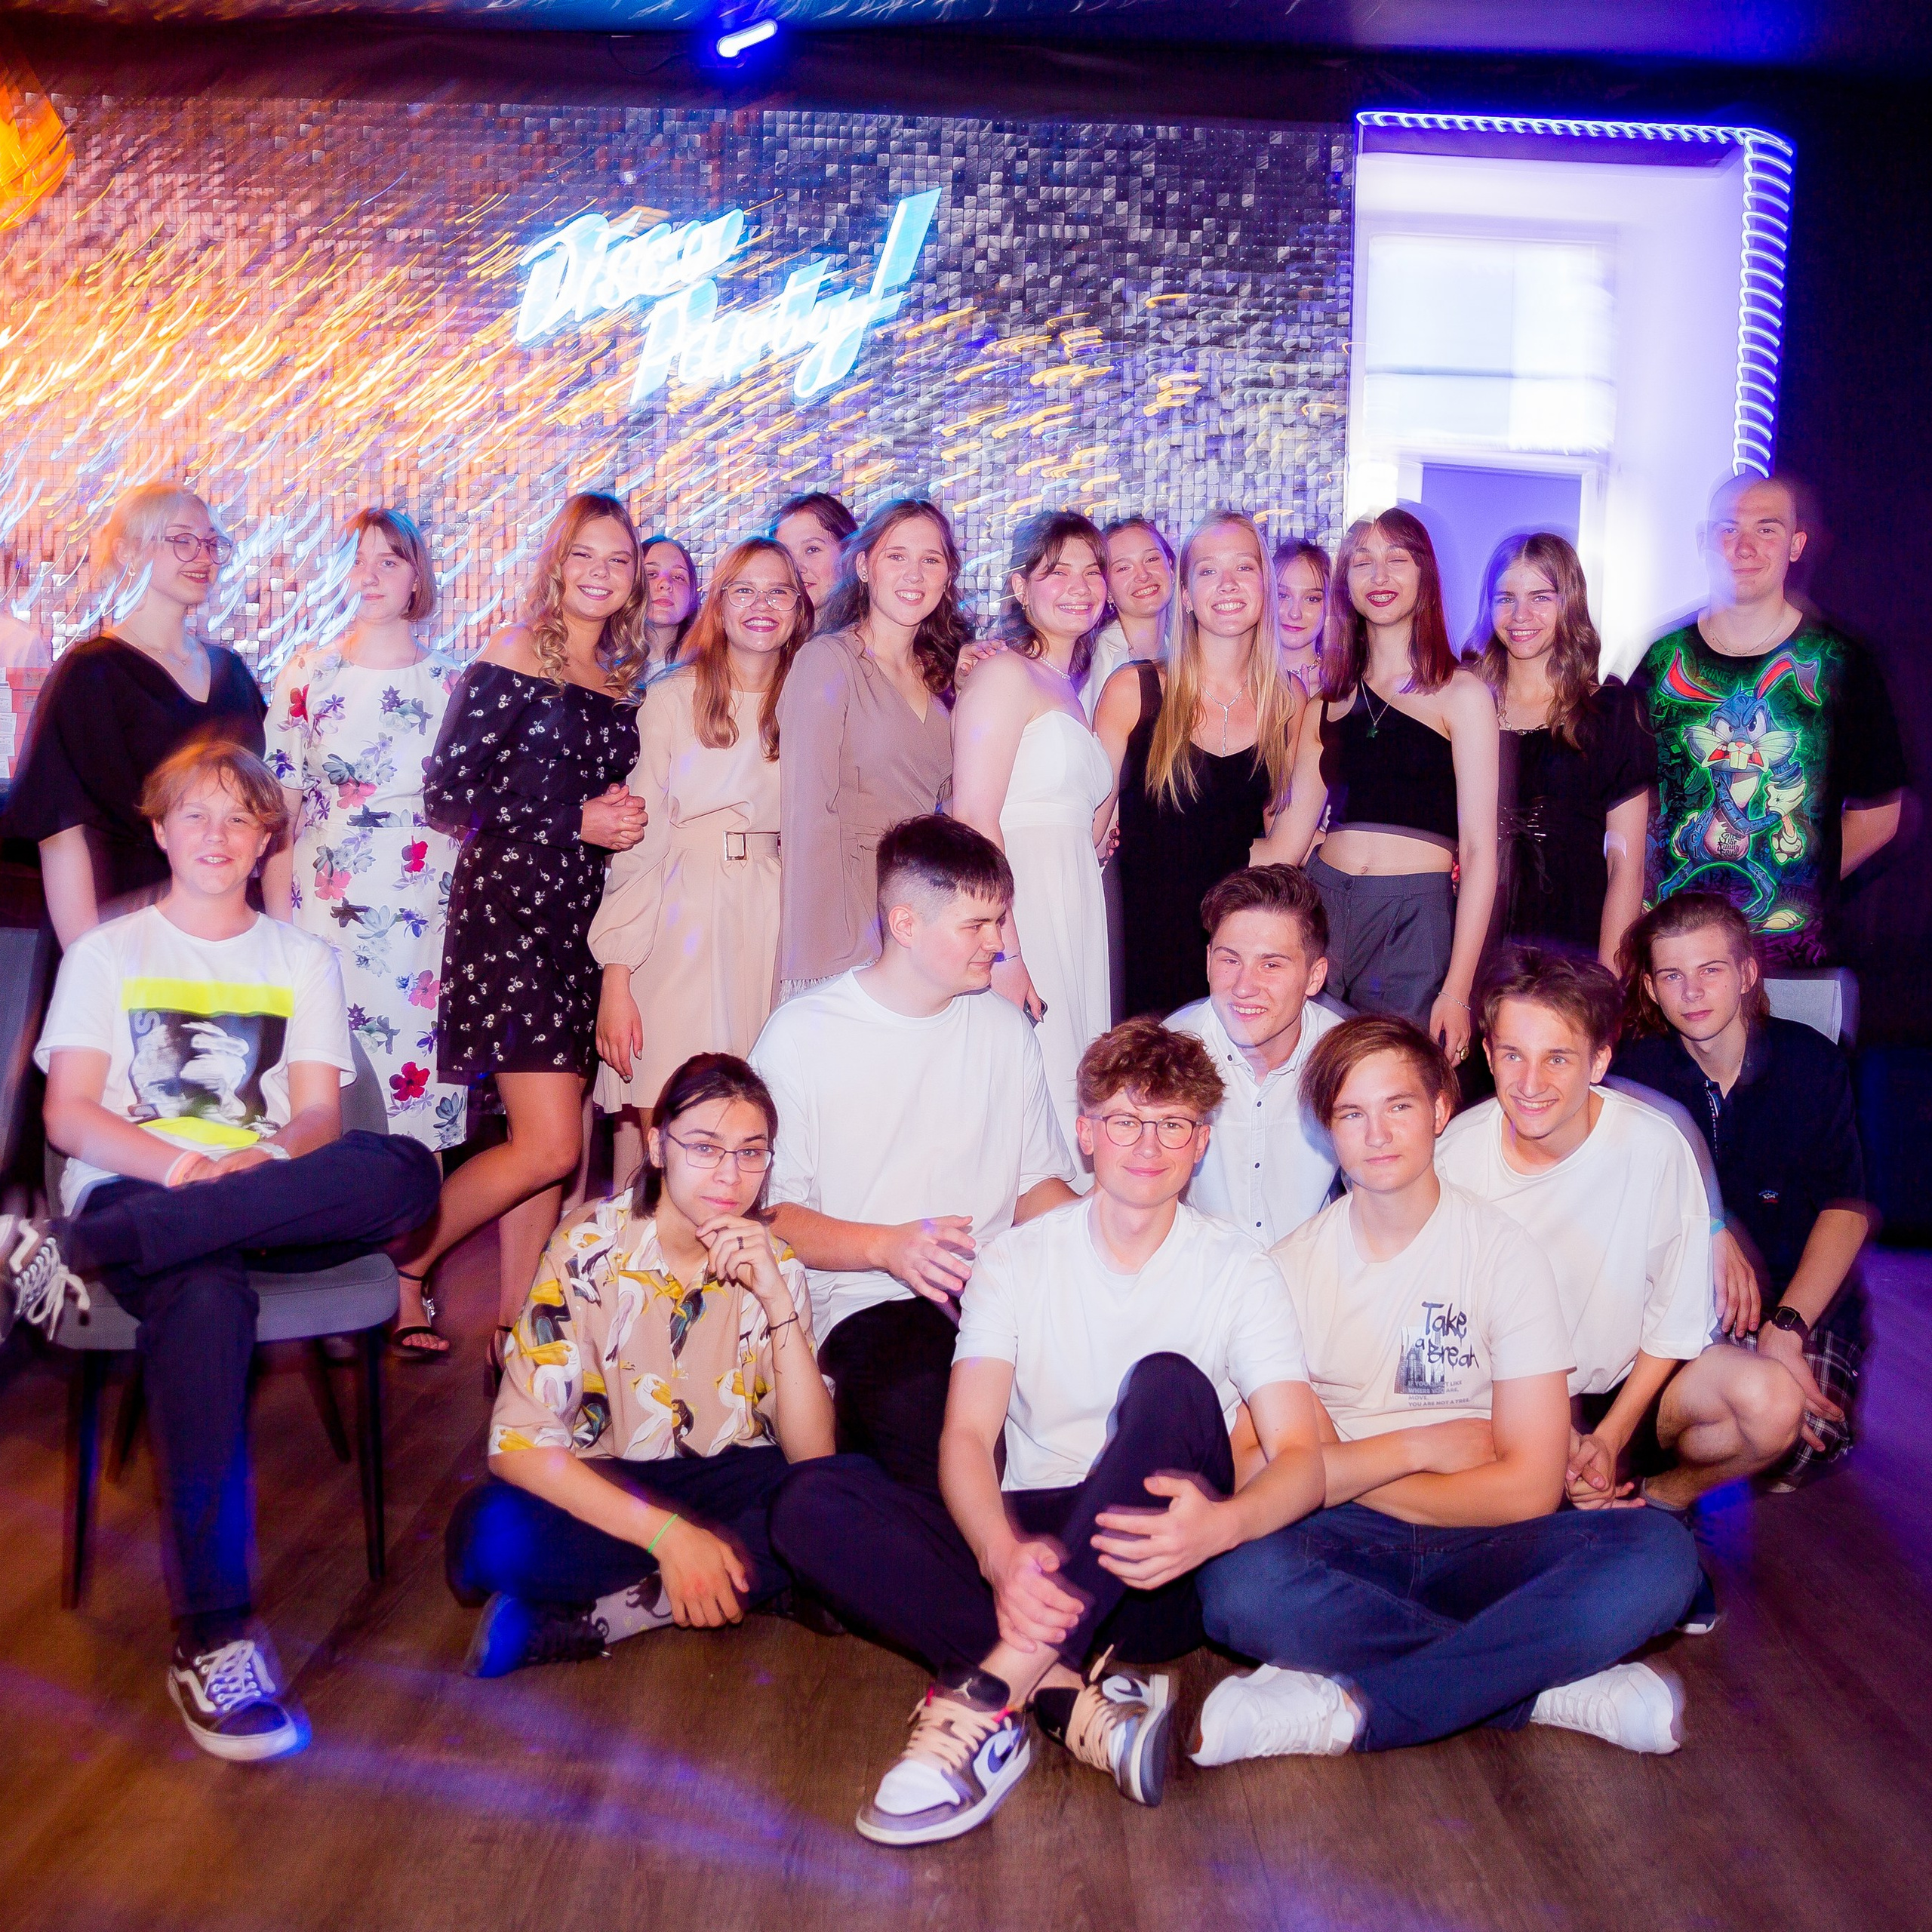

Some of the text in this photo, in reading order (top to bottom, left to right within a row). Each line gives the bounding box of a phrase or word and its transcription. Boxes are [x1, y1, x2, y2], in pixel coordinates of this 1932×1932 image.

[515, 210, 744, 344] Disco
[1415, 1338, 1425, 1350] a
[1421, 1301, 1467, 1344] Take
